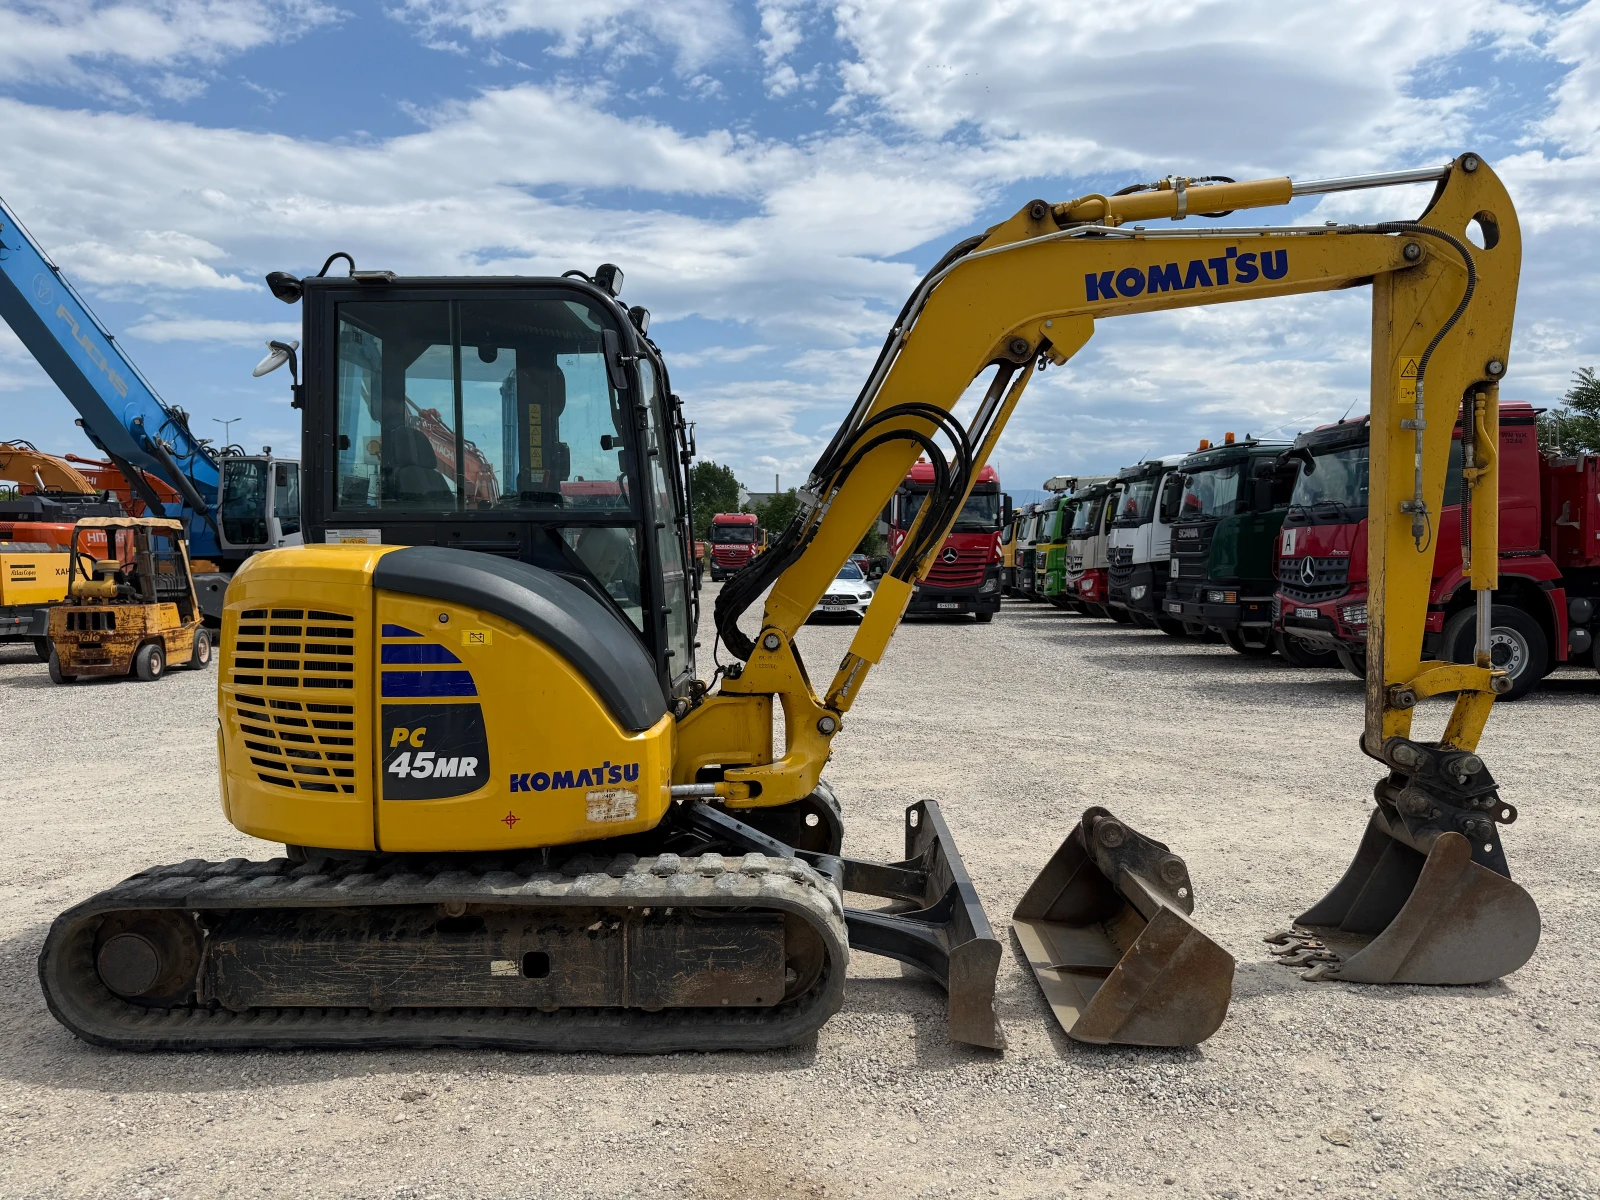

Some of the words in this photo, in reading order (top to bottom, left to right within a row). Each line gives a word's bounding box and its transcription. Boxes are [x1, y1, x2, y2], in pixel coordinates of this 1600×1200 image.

[1085, 247, 1288, 301] KOMATSU
[56, 304, 128, 398] FUCHS
[1178, 528, 1199, 538] SCANIA
[78, 632, 101, 642] Yale
[390, 727, 427, 748] PC
[388, 752, 478, 778] 45MR
[510, 761, 639, 793] KOMATSU
